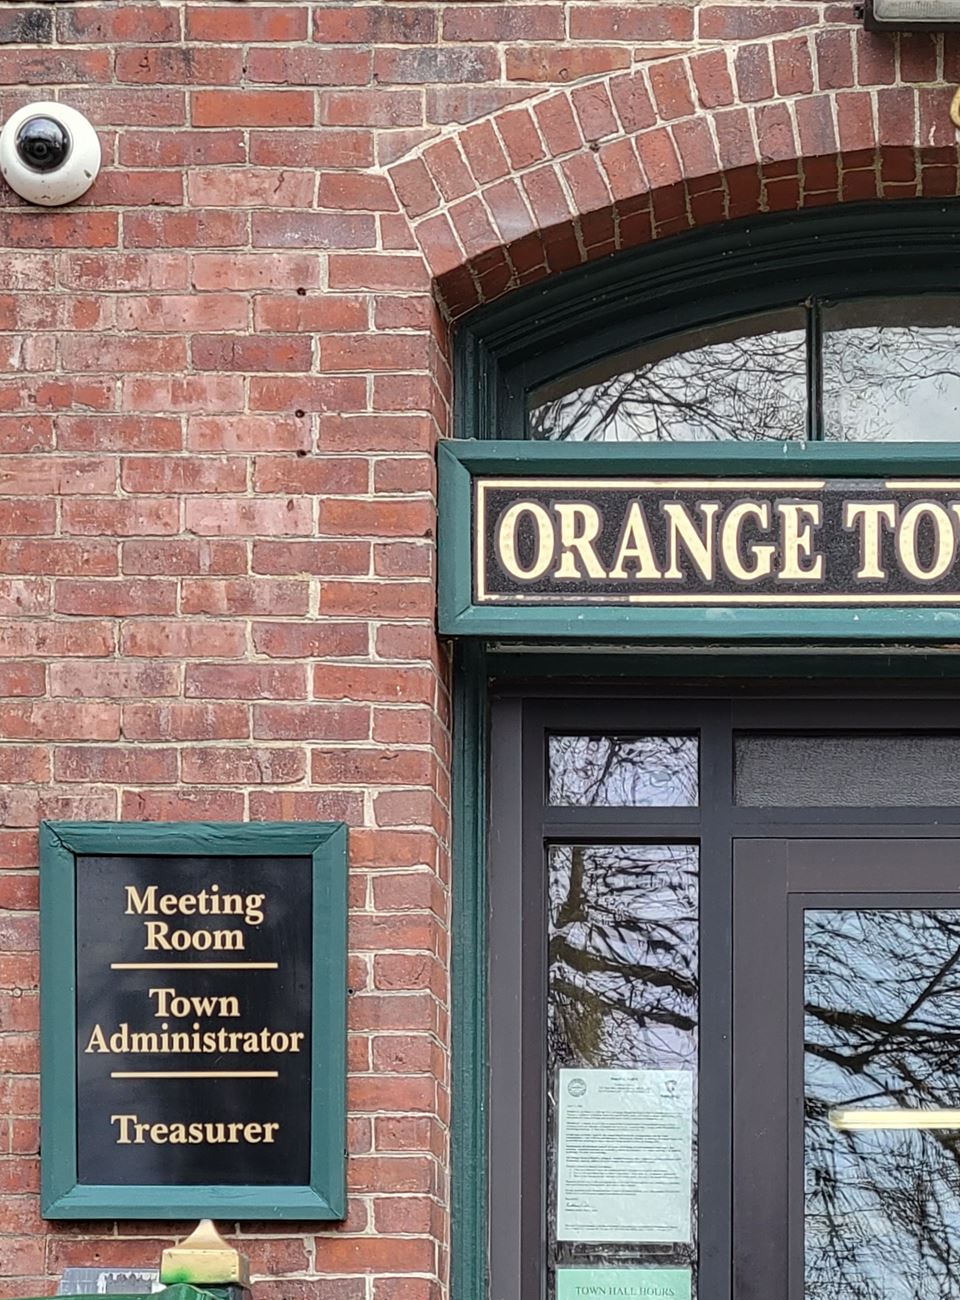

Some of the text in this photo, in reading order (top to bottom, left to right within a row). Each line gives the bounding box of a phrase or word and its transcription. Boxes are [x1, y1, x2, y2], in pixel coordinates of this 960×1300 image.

[500, 501, 824, 582] ORANGE
[124, 885, 265, 925] Meeting
[144, 922, 245, 951] Room
[149, 988, 240, 1018] Town
[84, 1023, 304, 1054] Administrator
[110, 1114, 280, 1144] Treasurer
[576, 1286, 676, 1297] TOWN HALL HOURS
